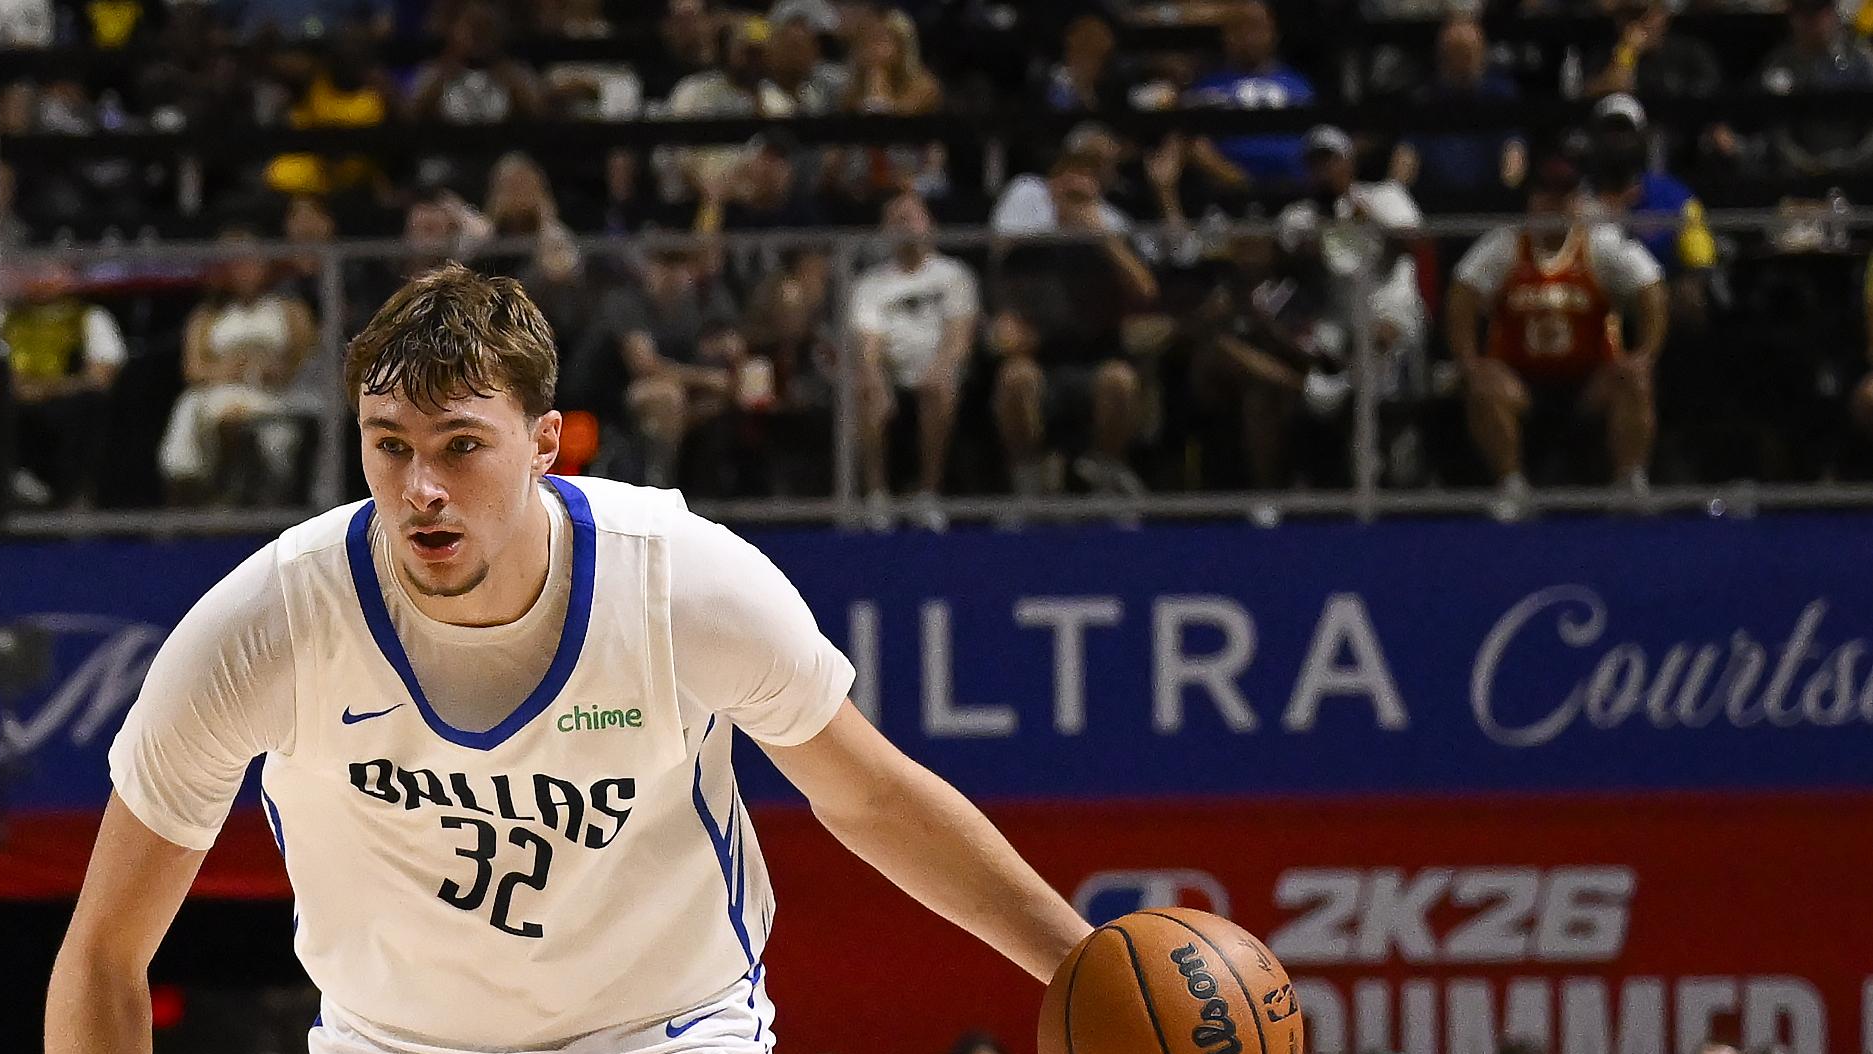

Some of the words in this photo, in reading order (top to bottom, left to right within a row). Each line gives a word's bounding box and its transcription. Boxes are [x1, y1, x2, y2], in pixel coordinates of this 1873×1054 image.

[1470, 583, 1873, 748] Courts
[557, 704, 642, 733] chime
[348, 758, 636, 849] DALLAS
[437, 816, 554, 939] 32
[1267, 865, 1637, 965] 2K26
